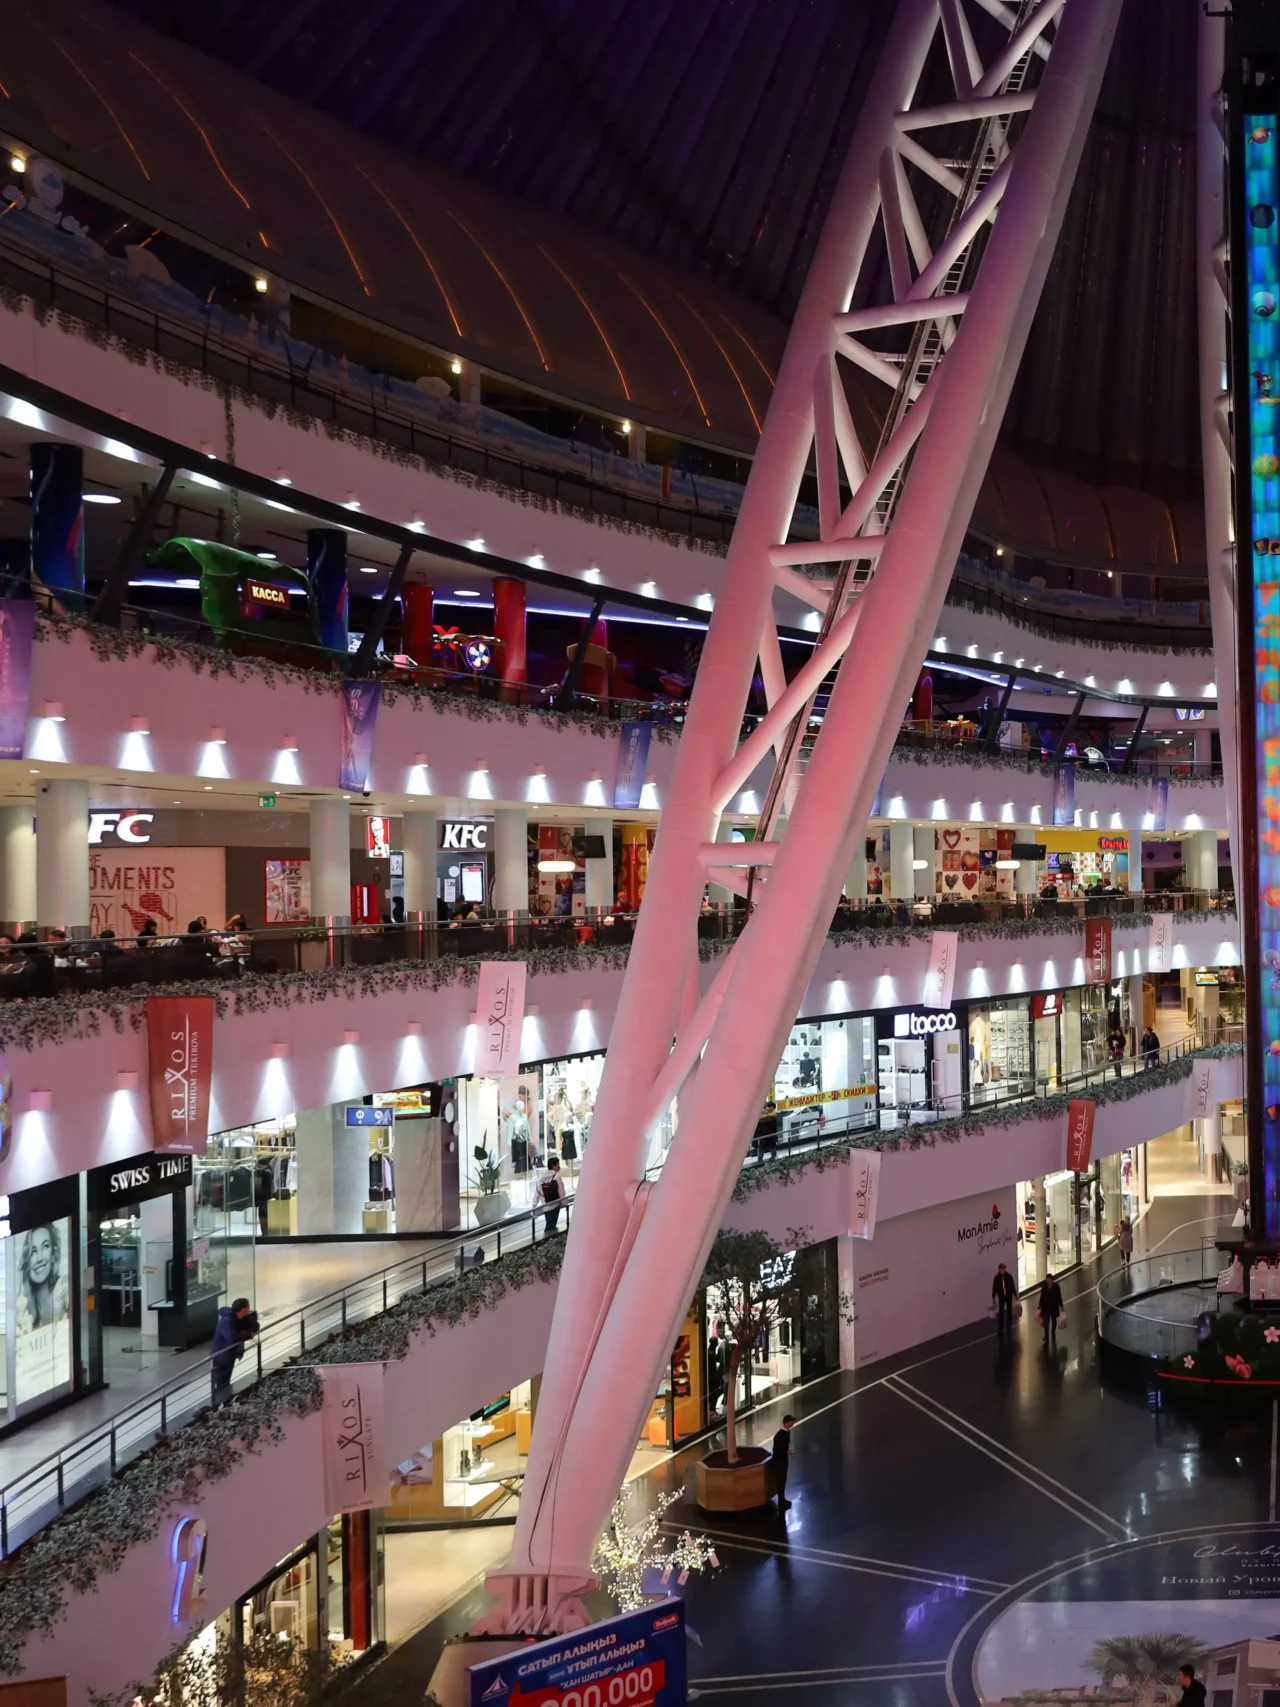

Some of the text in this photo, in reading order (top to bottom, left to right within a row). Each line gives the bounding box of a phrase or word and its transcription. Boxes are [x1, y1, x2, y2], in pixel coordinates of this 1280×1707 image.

[251, 585, 286, 604] КАССА
[88, 813, 154, 843] FC
[443, 824, 488, 849] KFC
[1093, 933, 1103, 971] RIXOS
[488, 987, 507, 1052] RIXOS
[911, 1012, 957, 1035] tacco
[165, 1030, 188, 1120] RIXOS
[189, 1031, 199, 1121] PREMIUM TEKIROVA
[1074, 1114, 1084, 1156] RIXOS
[110, 1155, 190, 1193] SWISS TIME
[856, 1169, 867, 1219] RIXOS
[957, 1217, 999, 1242] MonAmie
[337, 1398, 363, 1482] RIXOS
[365, 1416, 374, 1460] SUNGATE
[1161, 1574, 1227, 1584] Новый
[517, 1633, 617, 1677] САТЫП АЛЫҢЫЗ
[598, 1638, 646, 1667] АЛЫҢЫЗ
